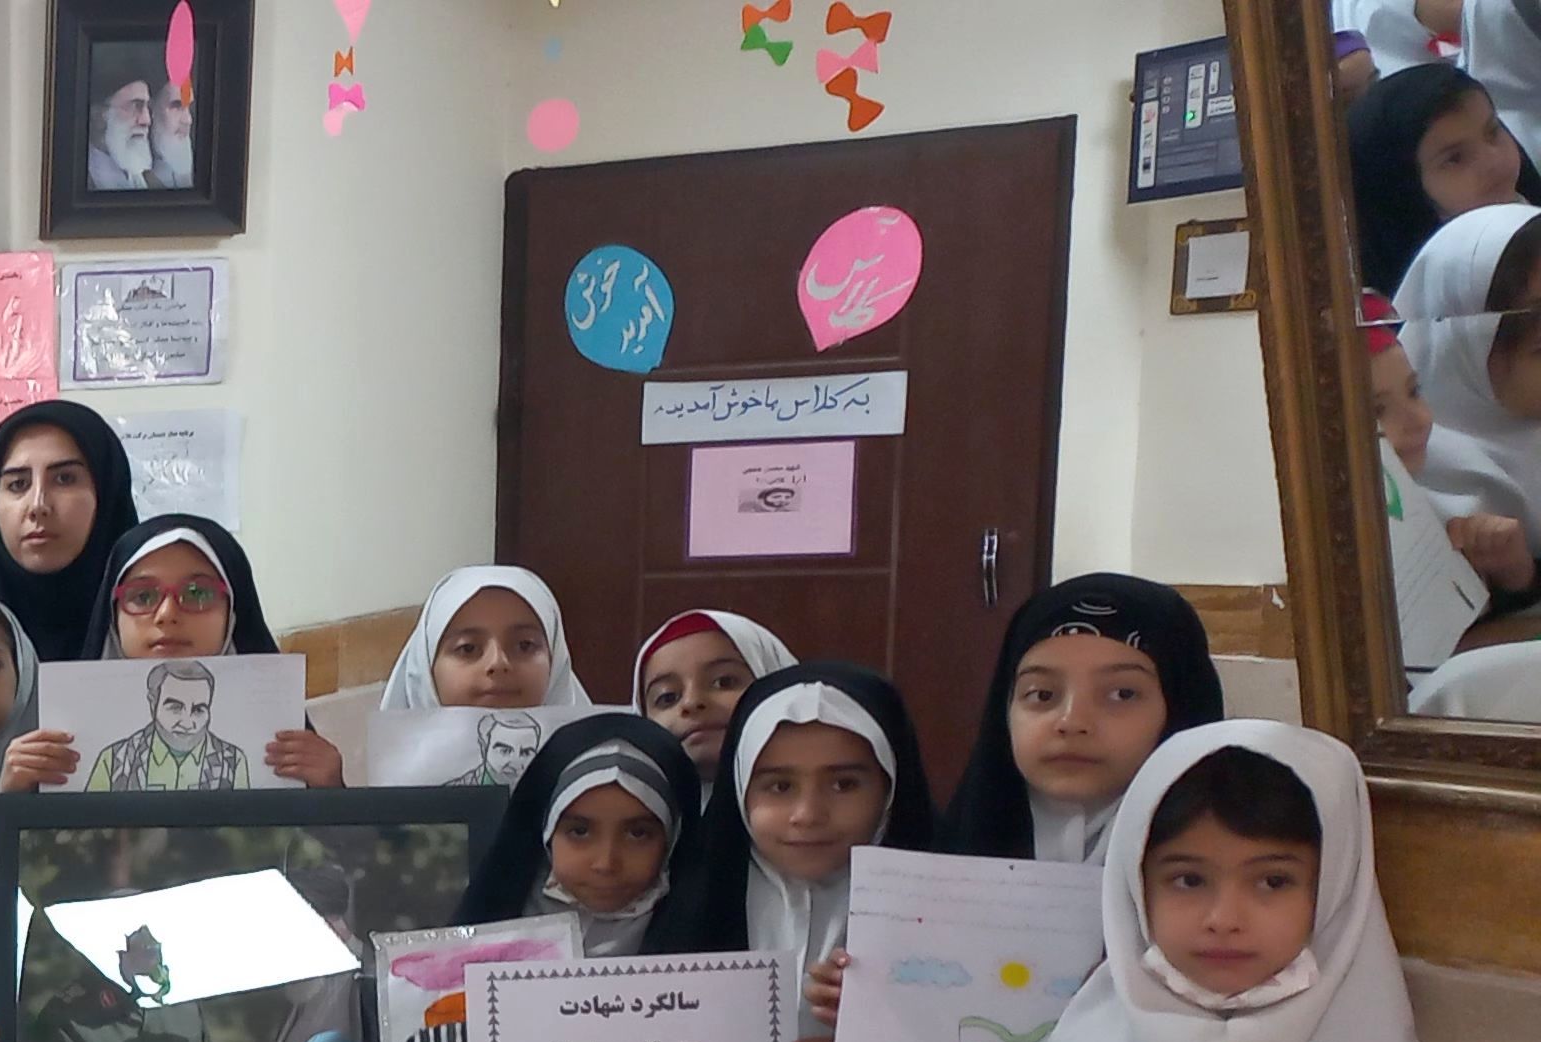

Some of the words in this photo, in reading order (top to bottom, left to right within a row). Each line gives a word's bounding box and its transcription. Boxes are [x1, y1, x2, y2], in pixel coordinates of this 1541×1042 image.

[571, 256, 621, 330] خوش
[621, 263, 666, 354] آمدید
[805, 253, 914, 328] کلاس
[713, 386, 763, 422] خوش
[778, 378, 865, 422] کلاس
[844, 391, 871, 415] به
[559, 994, 625, 1018] شهادت
[630, 991, 700, 1019] سالگرد
